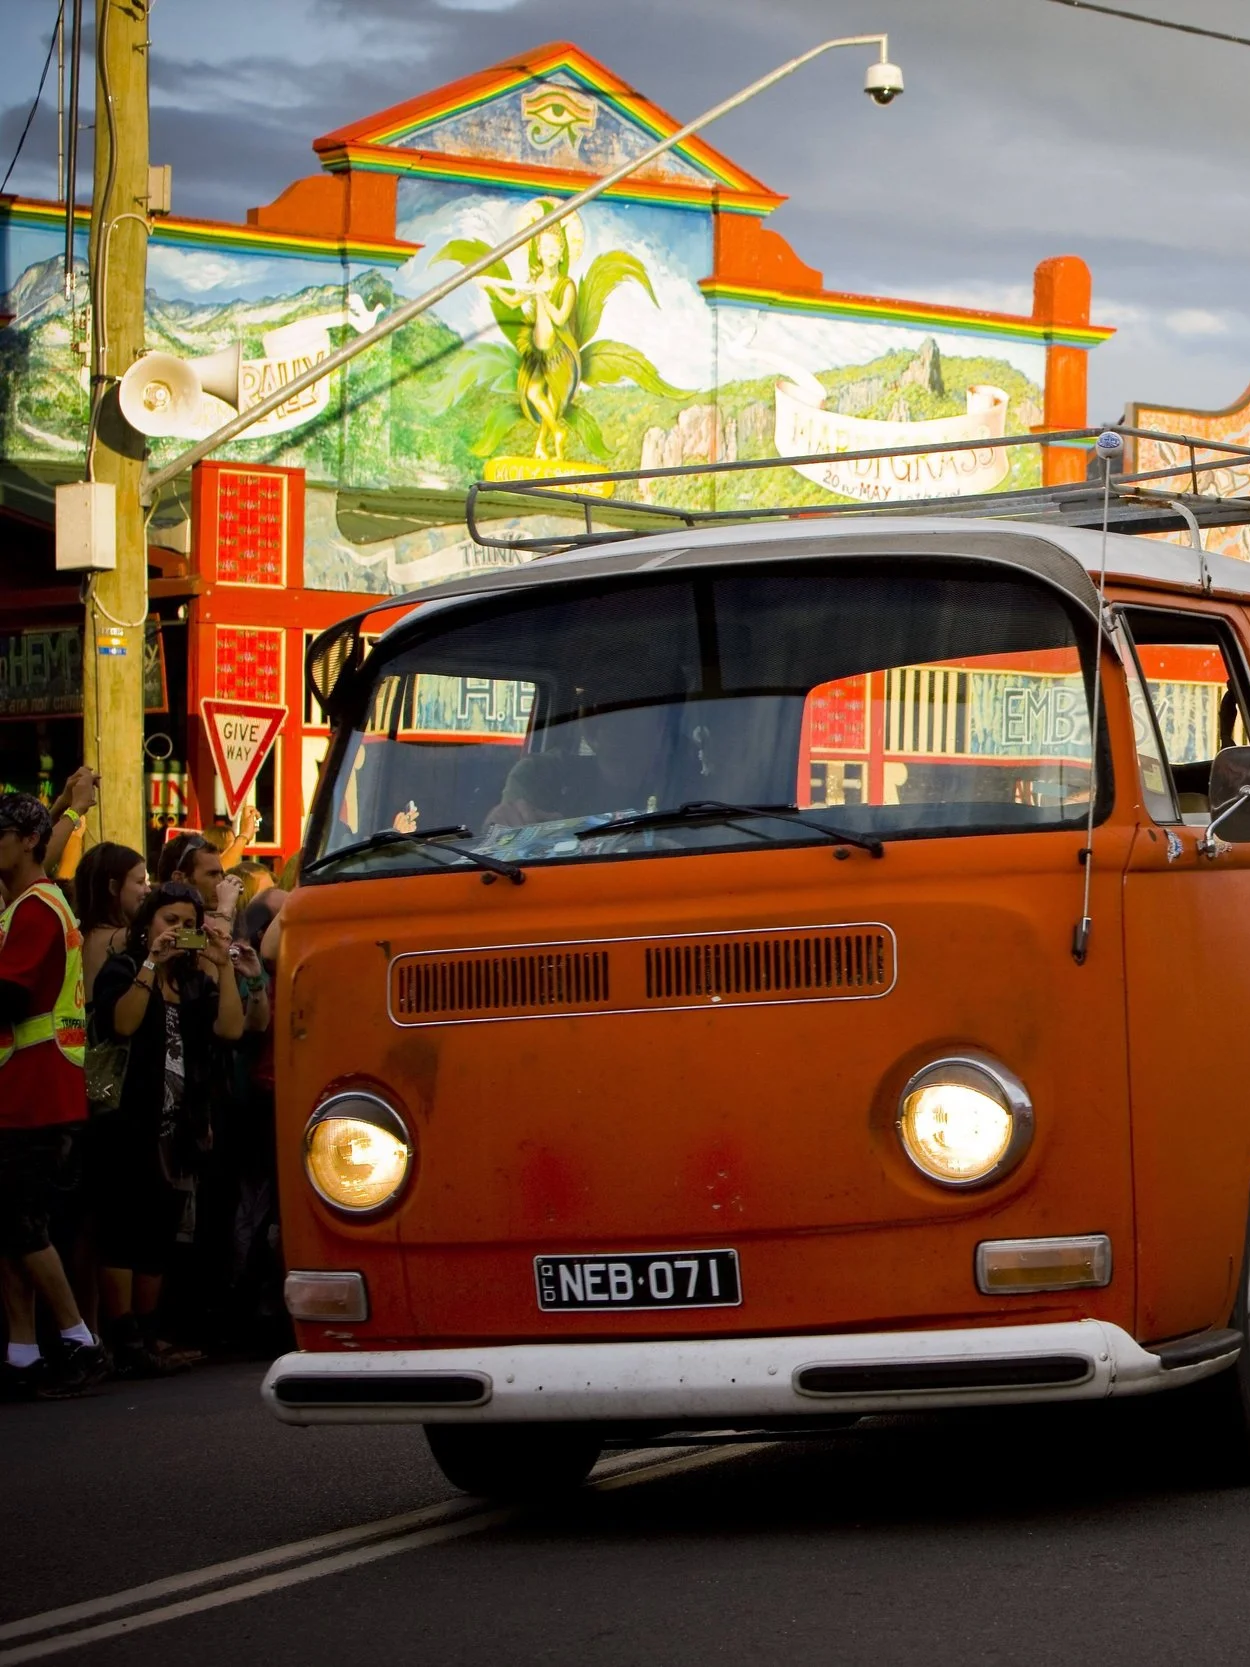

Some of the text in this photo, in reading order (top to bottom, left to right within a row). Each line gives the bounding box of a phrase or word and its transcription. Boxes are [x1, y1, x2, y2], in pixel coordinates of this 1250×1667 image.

[459, 531, 523, 567] THINK
[223, 722, 259, 743] GIVE
[226, 744, 252, 761] WAY
[540, 1264, 556, 1302] QLD
